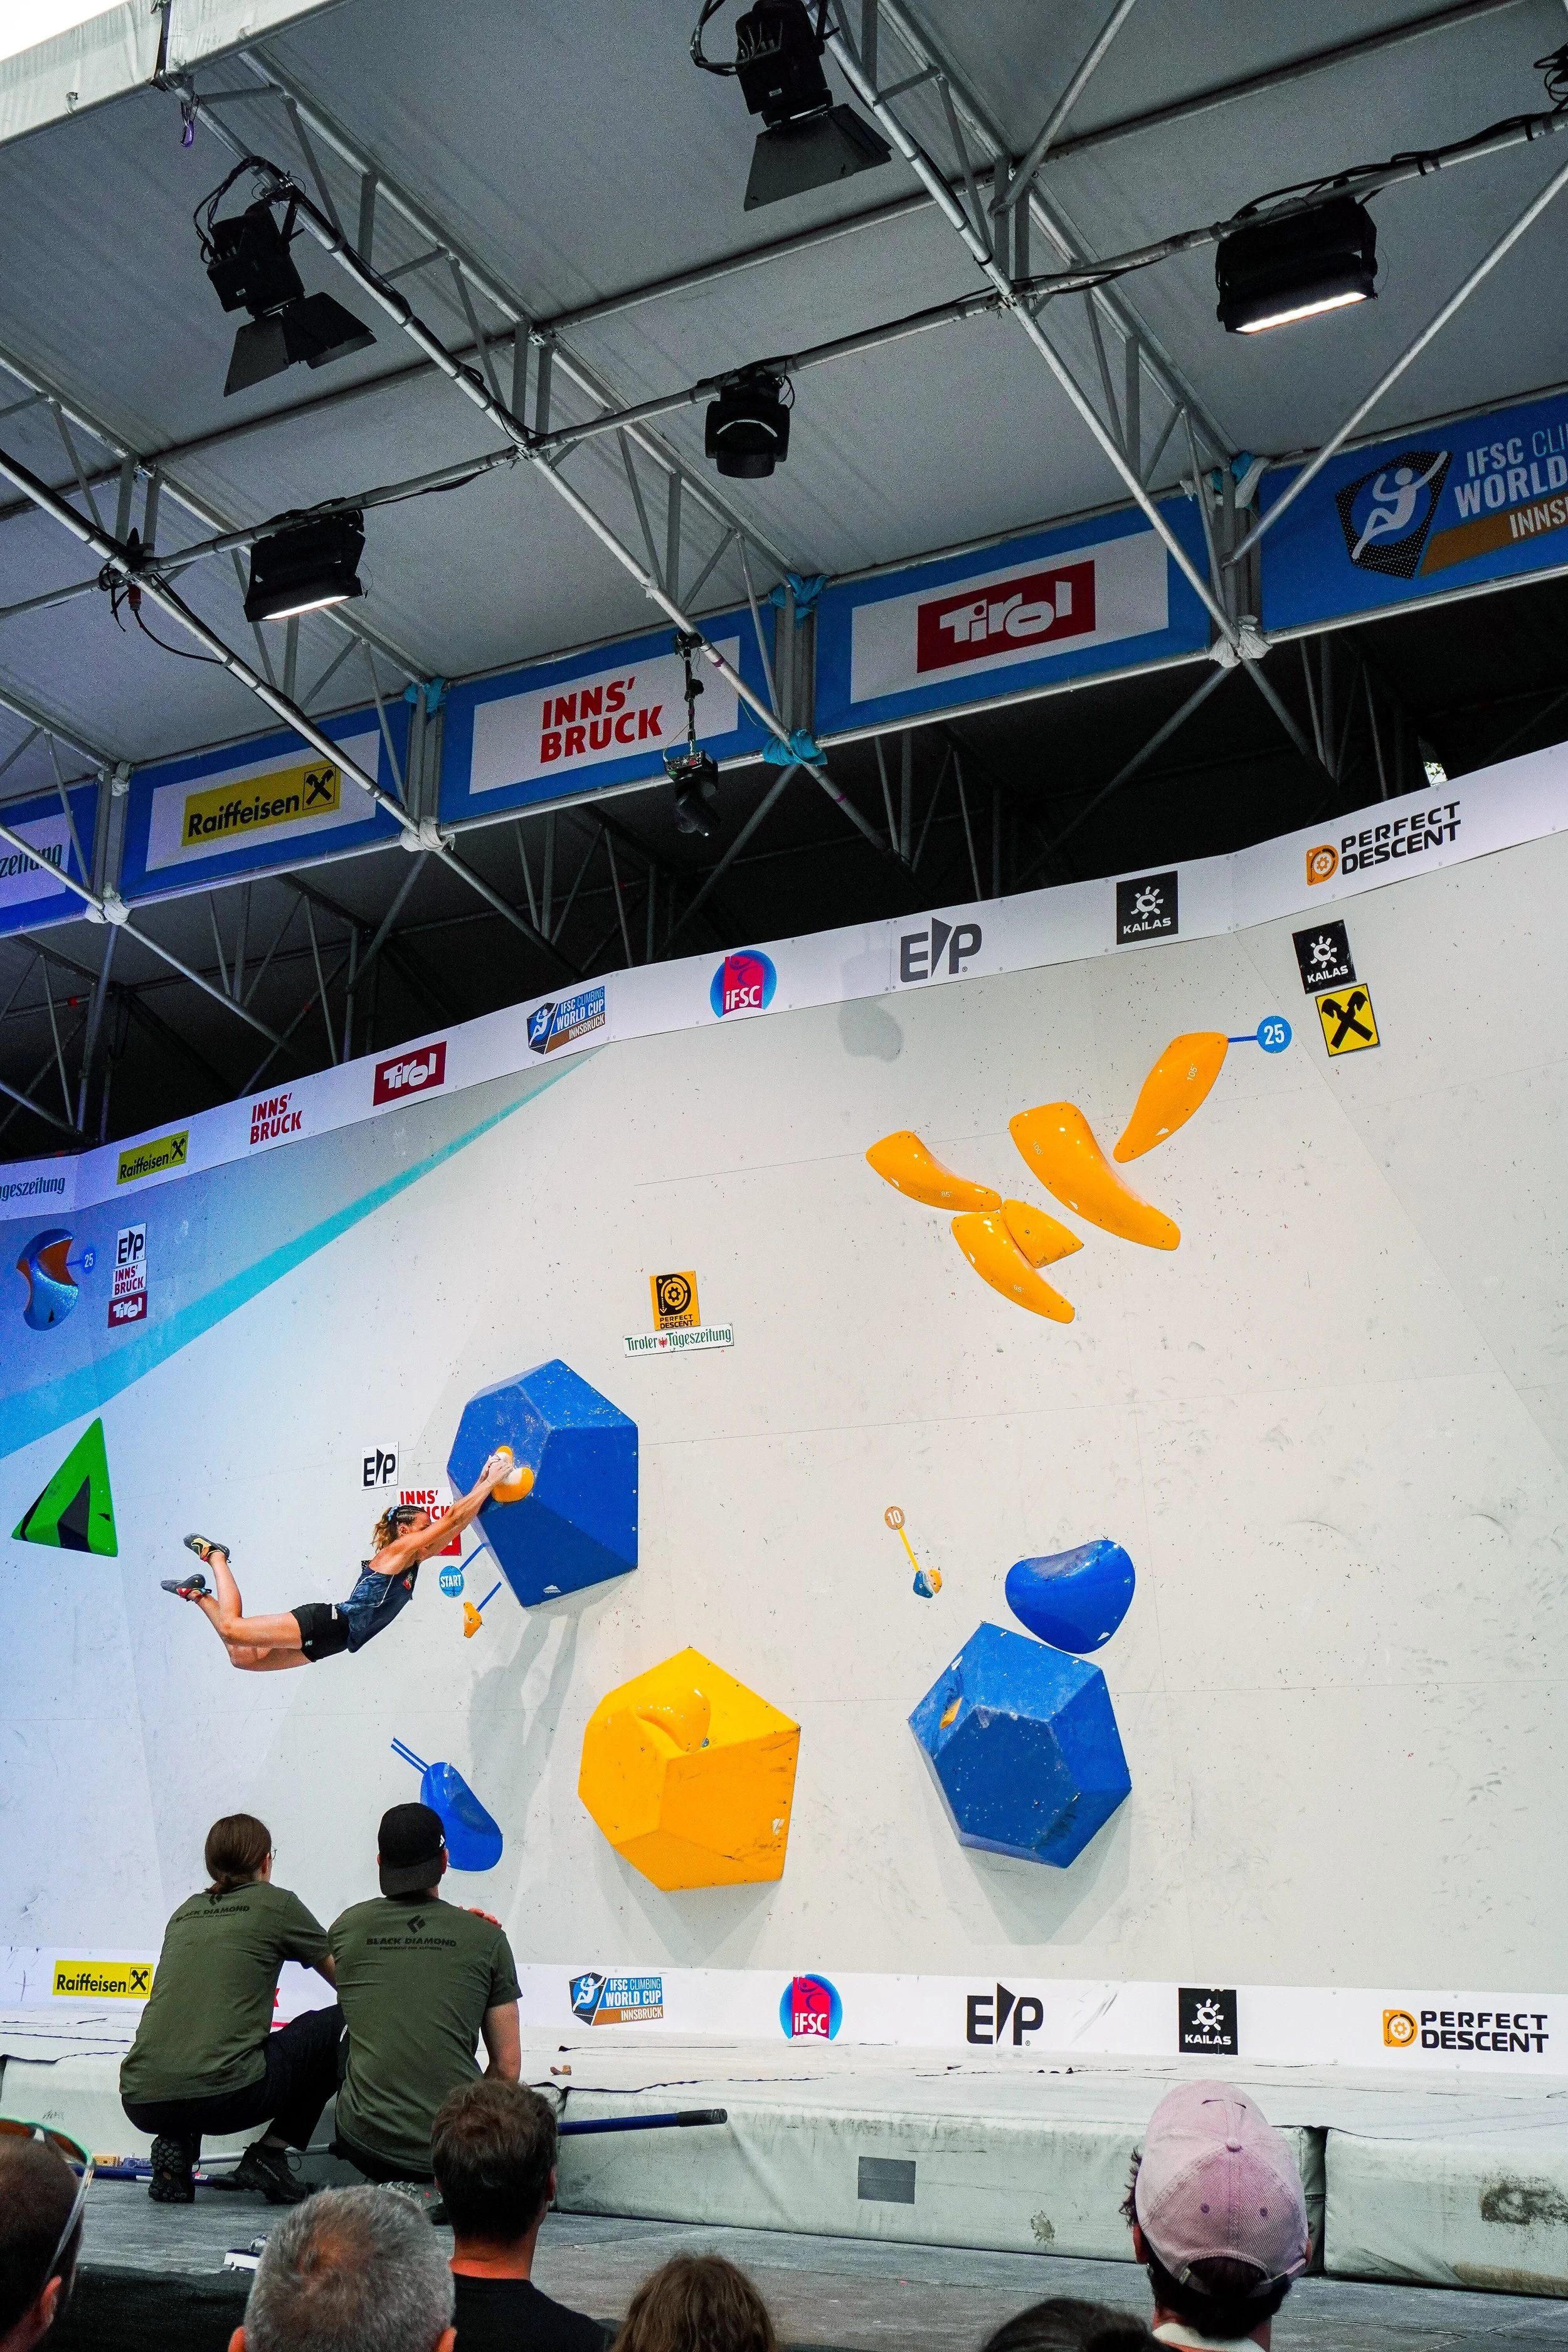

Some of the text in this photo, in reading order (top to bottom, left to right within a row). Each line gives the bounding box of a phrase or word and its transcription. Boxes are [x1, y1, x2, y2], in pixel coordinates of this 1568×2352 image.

[1466, 423, 1568, 478] IFSC CLI
[1454, 455, 1568, 518] WORLD
[1509, 496, 1568, 539] INNS
[940, 581, 1073, 644] Tirol
[540, 704, 663, 763] BRUCK
[188, 795, 300, 838] Raiffeisen
[1341, 800, 1460, 854] PERFECT
[1342, 819, 1461, 875] DESCENT
[1123, 917, 1172, 934] KAILAS
[1306, 965, 1348, 983] KAILAS
[561, 988, 604, 1014] IFSC CLIMBING
[556, 999, 604, 1031] WORLD CUP
[568, 1014, 605, 1040] INNSBRUCK
[1264, 1024, 1285, 1045] 25
[383, 1052, 437, 1089] Tirol
[250, 1110, 303, 1145] BRUCK
[120, 1153, 169, 1179] Raiffeisen
[0, 1177, 65, 1202] geszeitung
[84, 1253, 93, 1268] 25
[114, 1276, 144, 1296] BRUCK
[112, 1297, 142, 1318] Tirol
[660, 1314, 693, 1322] PERFECT
[660, 1320, 694, 1329] DESCENT
[625, 1328, 731, 1351] Tiroler Tageszeitung
[887, 1510, 902, 1525] 10
[440, 1574, 462, 1588] START
[203, 1905, 250, 1915] DIAMOND
[405, 1937, 457, 1947] DIAMOND
[56, 1973, 127, 1993] Raiffeisen
[610, 1978, 661, 1991] IFSC CLIMBING
[605, 1990, 662, 2007] WORLD CUP
[621, 2006, 663, 2021] INNSBRUCK
[1421, 2010, 1548, 2030] PERFECT
[1185, 2034, 1232, 2045] KAILAS
[1421, 2029, 1549, 2053] DESCENT
